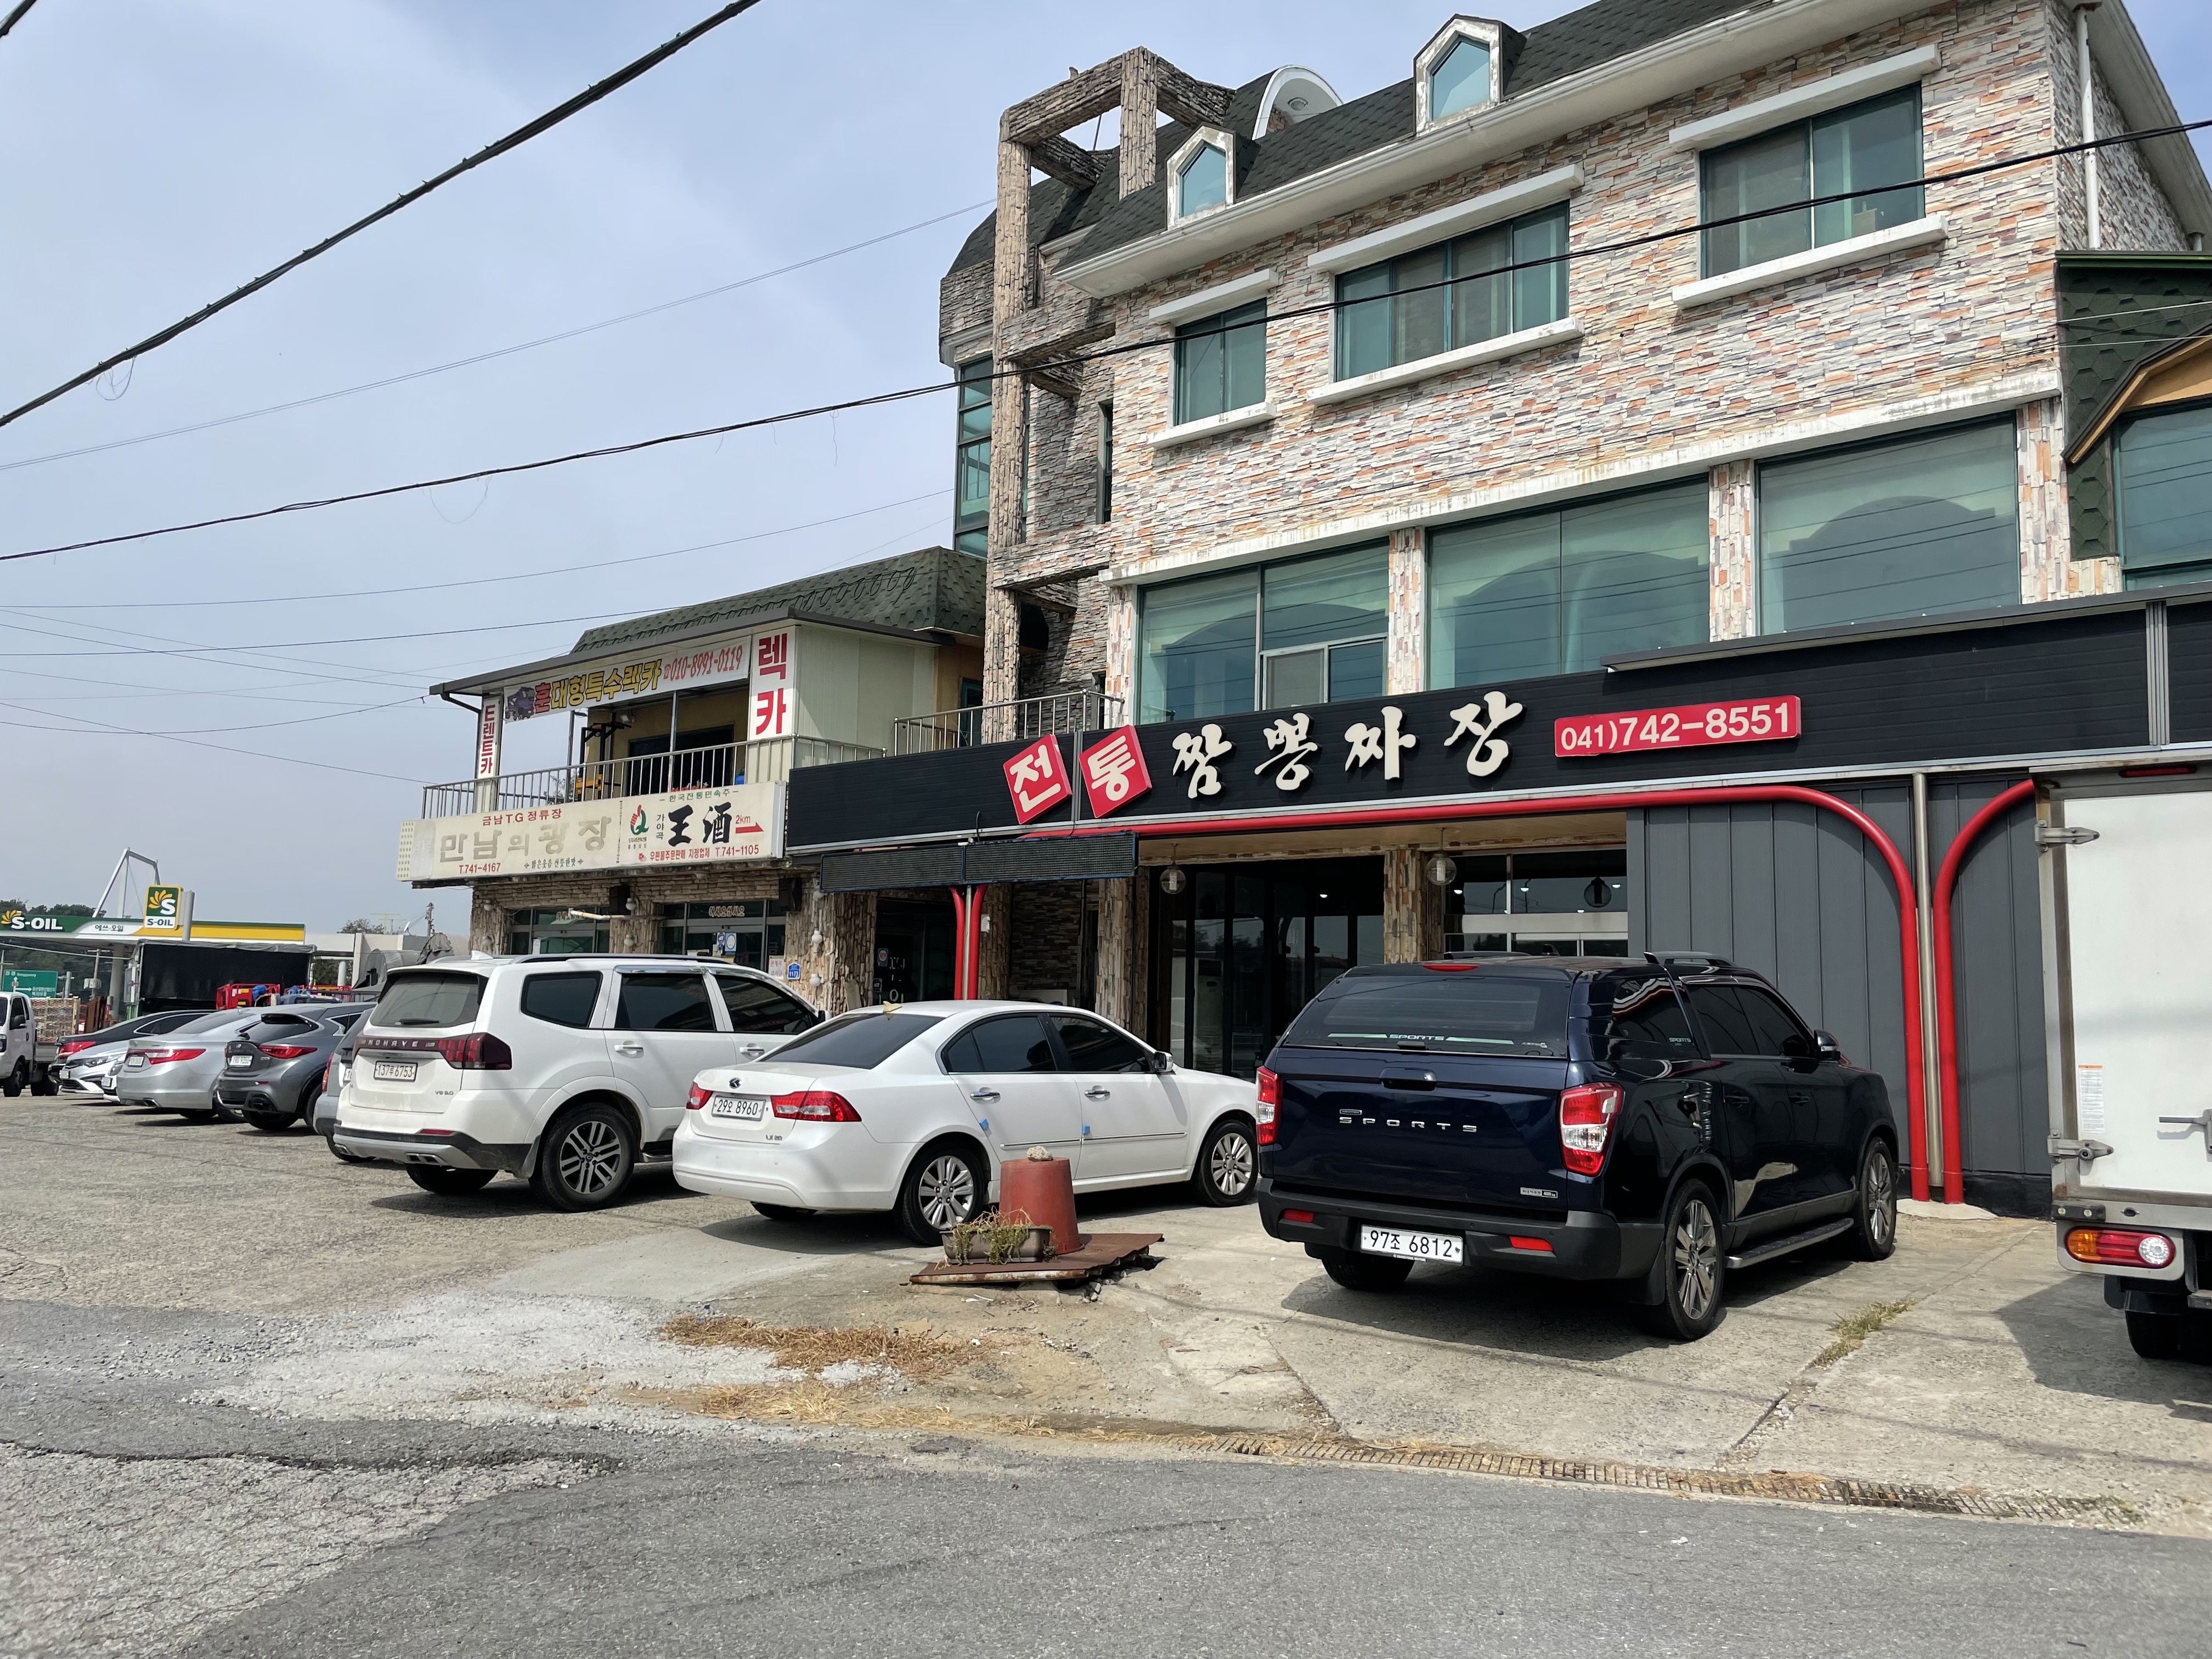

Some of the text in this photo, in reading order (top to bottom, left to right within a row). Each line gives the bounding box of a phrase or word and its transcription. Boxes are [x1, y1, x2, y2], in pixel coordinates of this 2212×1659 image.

[670, 645, 742, 681] 010-8991-0119
[755, 633, 788, 735] 렉카
[1560, 702, 1789, 751] 041)742-8551
[1009, 743, 1137, 813] 전통
[482, 815, 504, 826] 금남
[527, 808, 562, 821] 정류장
[656, 813, 665, 840] 가야곡
[668, 801, 732, 847] 王酒
[735, 815, 751, 824] 2km
[688, 847, 710, 859] 지정업체
[715, 844, 759, 857] T.741-1105
[459, 862, 501, 874] T.741-4167
[11, 916, 63, 930] S-OIL
[736, 1101, 758, 1116] 8960
[1339, 1116, 1477, 1133] SPORTS
[1370, 1229, 1452, 1258] 97조 6812
